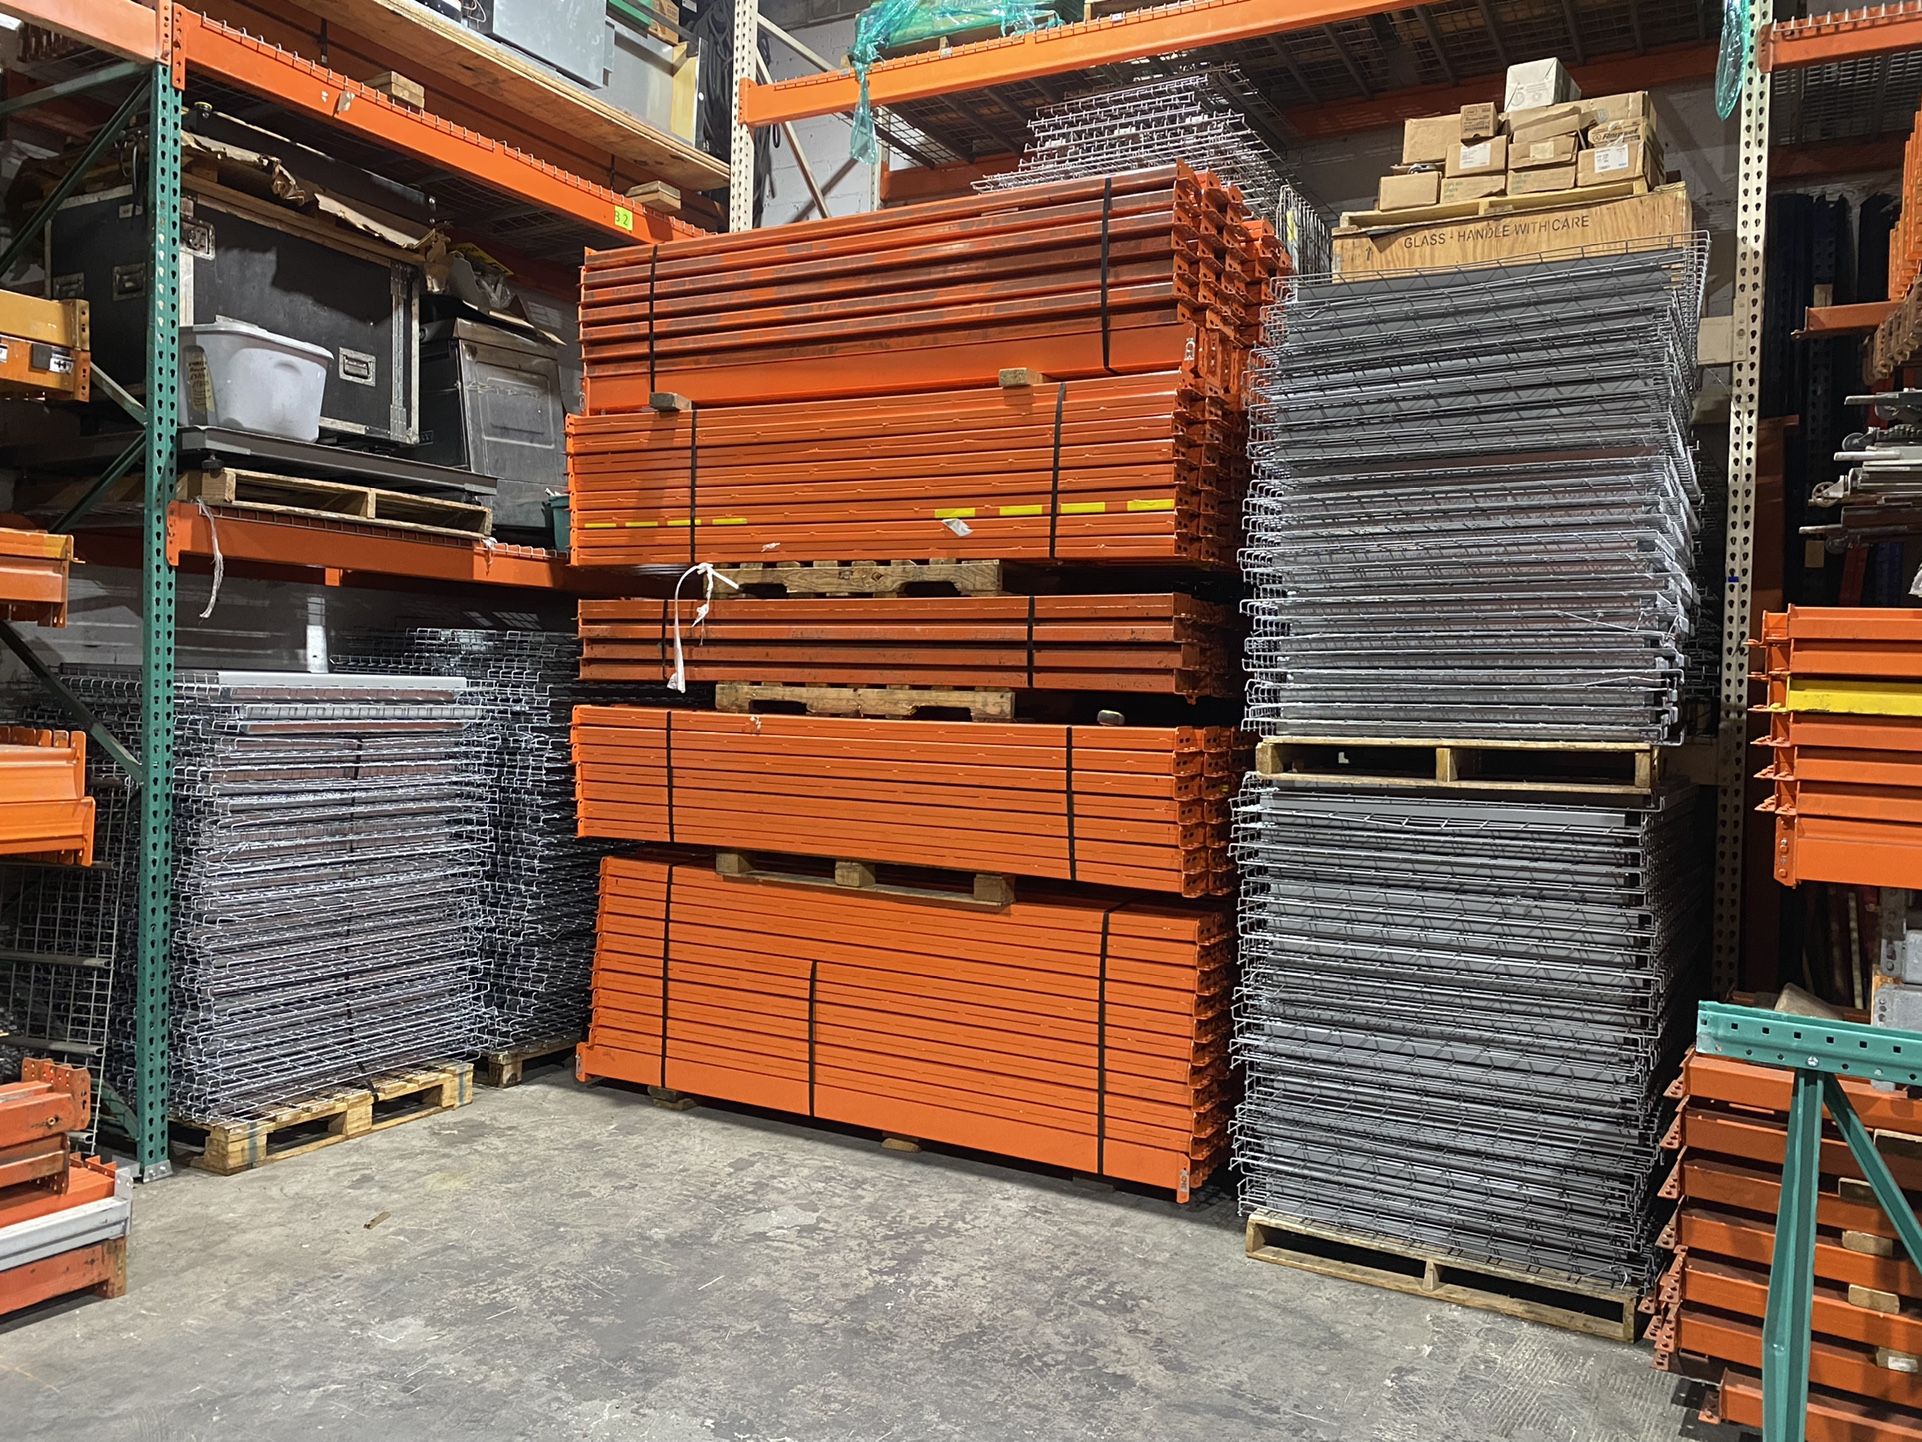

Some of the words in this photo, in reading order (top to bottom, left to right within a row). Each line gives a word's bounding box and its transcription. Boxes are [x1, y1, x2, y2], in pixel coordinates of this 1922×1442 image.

[1404, 232, 1446, 249] GLASS
[1457, 224, 1510, 242] HANDLE
[1514, 220, 1548, 235] WITH
[1551, 215, 1590, 232] CARE
